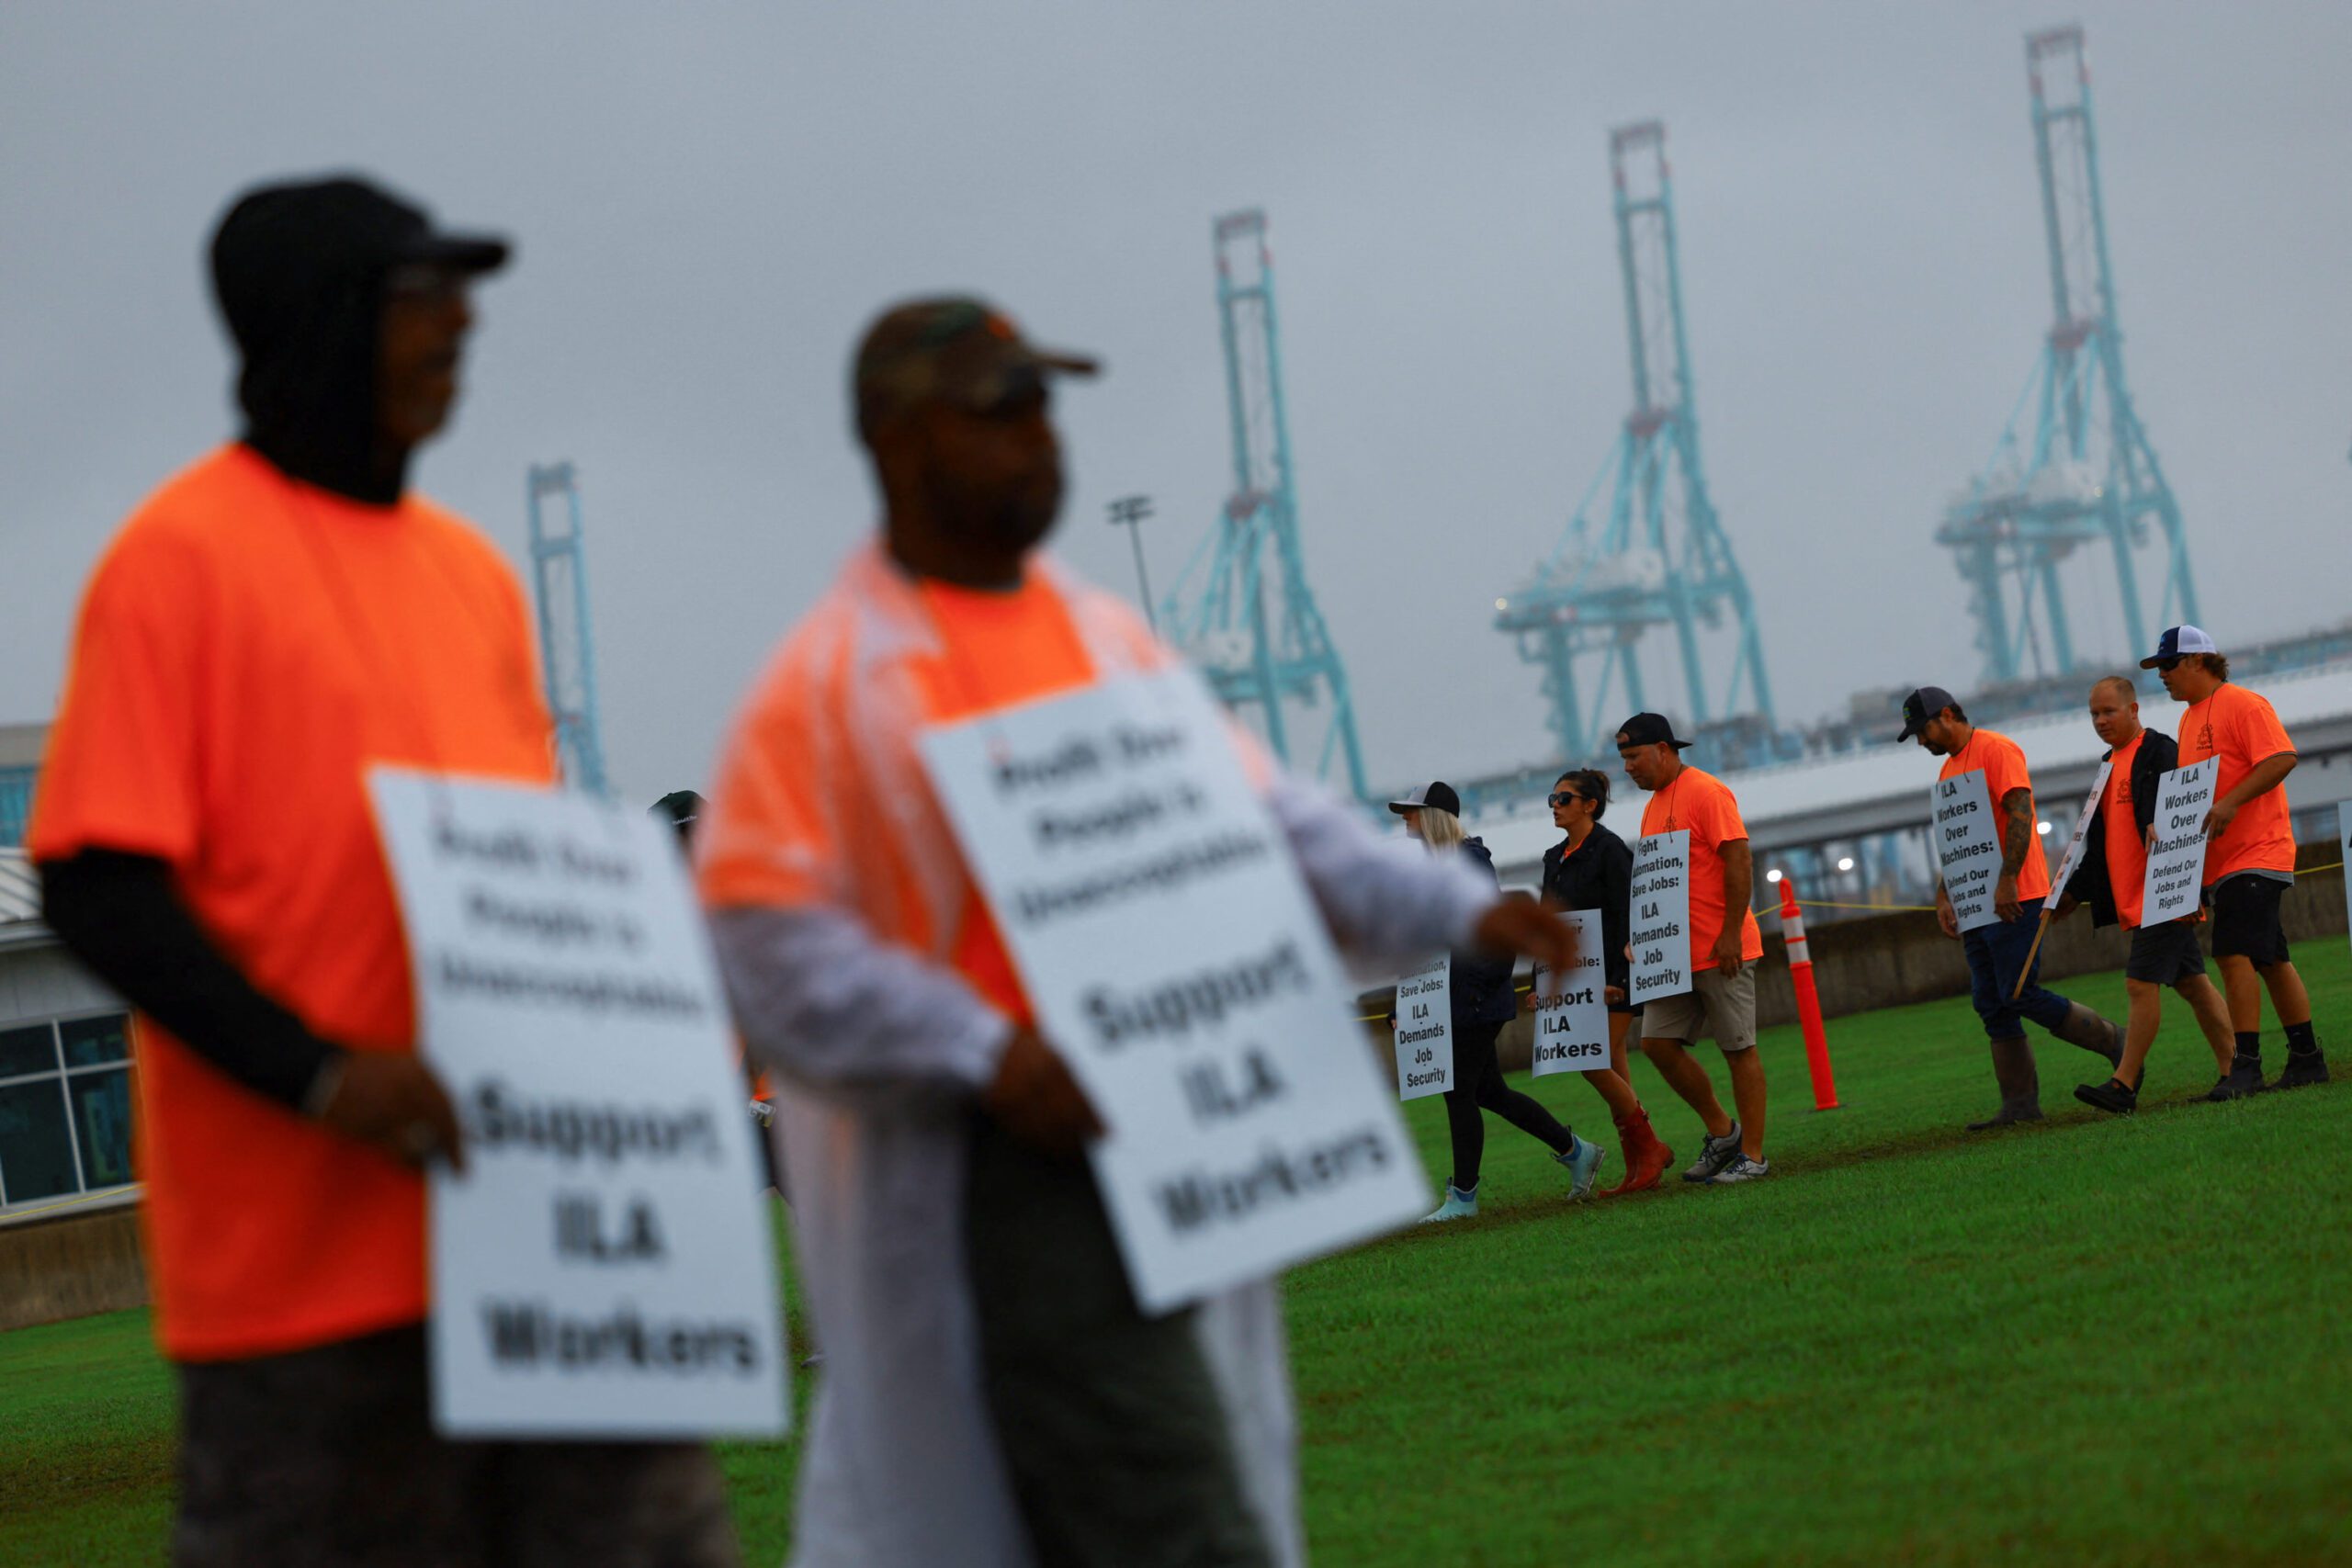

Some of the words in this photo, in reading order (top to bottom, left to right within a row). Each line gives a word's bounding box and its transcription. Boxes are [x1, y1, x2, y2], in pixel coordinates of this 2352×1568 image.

[2181, 768, 2199, 785] ILA
[1941, 781, 1957, 799] ILA
[2165, 788, 2208, 810] Workers
[1937, 801, 1977, 823] Workers
[2171, 813, 2198, 829] Over
[1945, 825, 1968, 841] Over
[1940, 840, 1994, 867] Machines:
[1969, 869, 1989, 881] Our
[2153, 862, 2183, 879] Defend
[2185, 859, 2198, 871] Our
[1632, 884, 1646, 898] Save
[1648, 876, 1679, 892] Jobs:
[1967, 884, 1986, 898] and
[2154, 881, 2176, 895] Jobs
[2177, 874, 2192, 889] and
[1641, 902, 1659, 920] ILA
[2158, 895, 2184, 909] Rights
[1632, 922, 1679, 946] Demands
[1643, 948, 1663, 965] Job
[1400, 986, 1419, 998] Save
[1420, 978, 1443, 993] Jobs:
[1635, 968, 1680, 991] Security
[1086, 943, 1308, 1049] Support
[1535, 987, 1593, 1012] Support
[1412, 1003, 1429, 1020] ILA
[1399, 1022, 1444, 1044] Demands
[1544, 1015, 1571, 1035] ILA
[1415, 1047, 1432, 1065] Job
[1535, 1043, 1602, 1063] Workers
[1180, 1052, 1283, 1122] ILA
[1407, 1067, 1446, 1088] Security
[474, 1080, 724, 1163] Support
[1156, 1129, 1386, 1232] Workers
[553, 1197, 665, 1263] ILA
[482, 1299, 761, 1374] Workers
